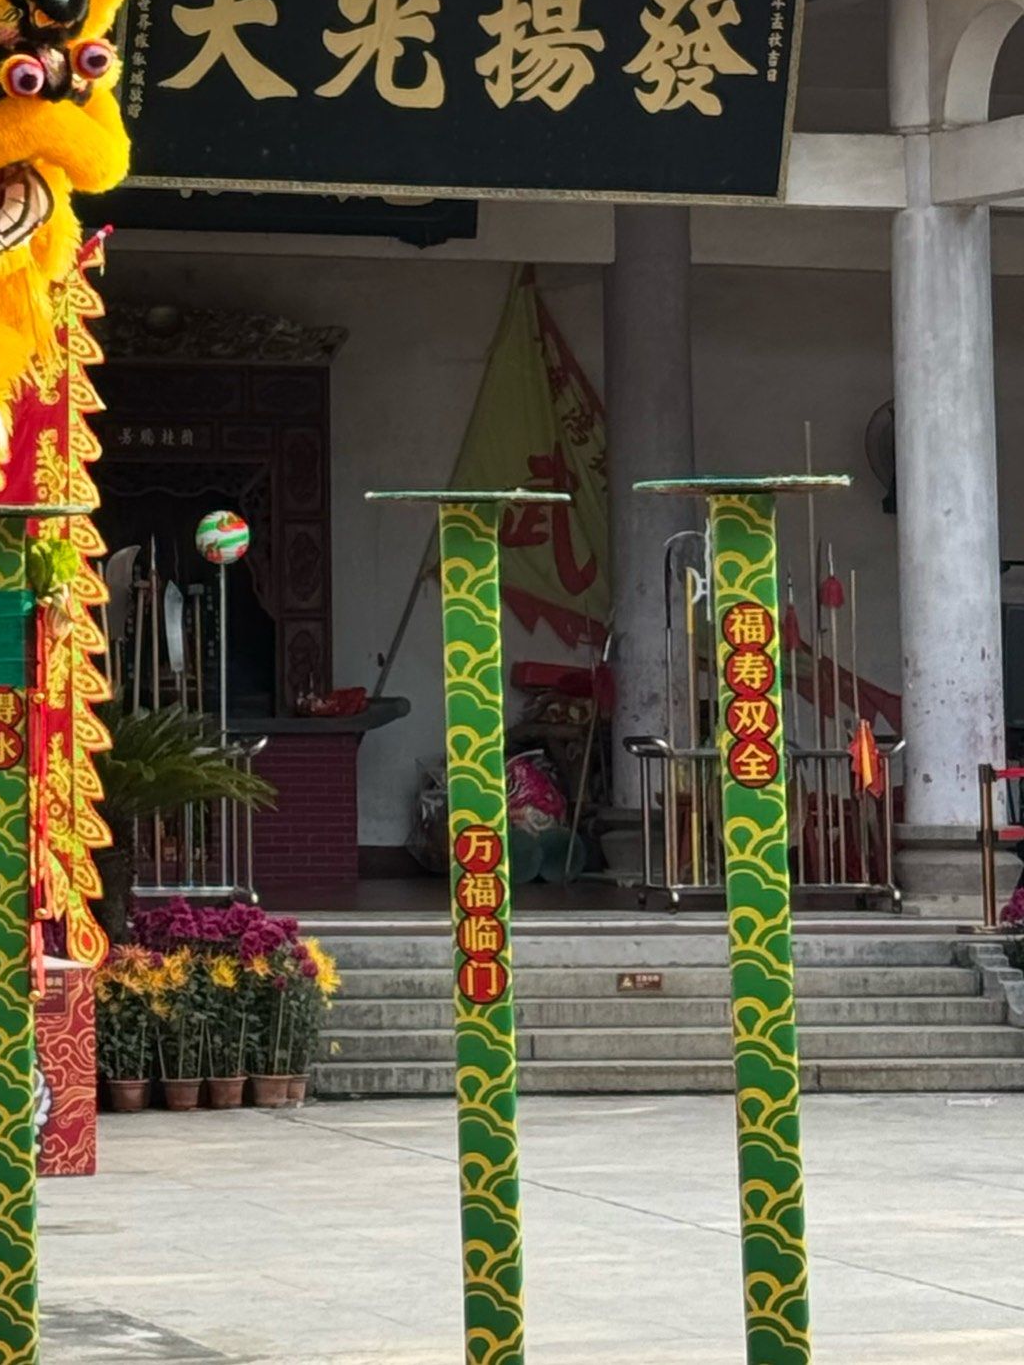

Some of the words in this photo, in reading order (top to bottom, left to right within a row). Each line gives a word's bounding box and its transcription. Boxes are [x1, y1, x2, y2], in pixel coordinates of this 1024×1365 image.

[730, 609, 773, 782] 福寿双全
[459, 831, 501, 999] 万福临门
